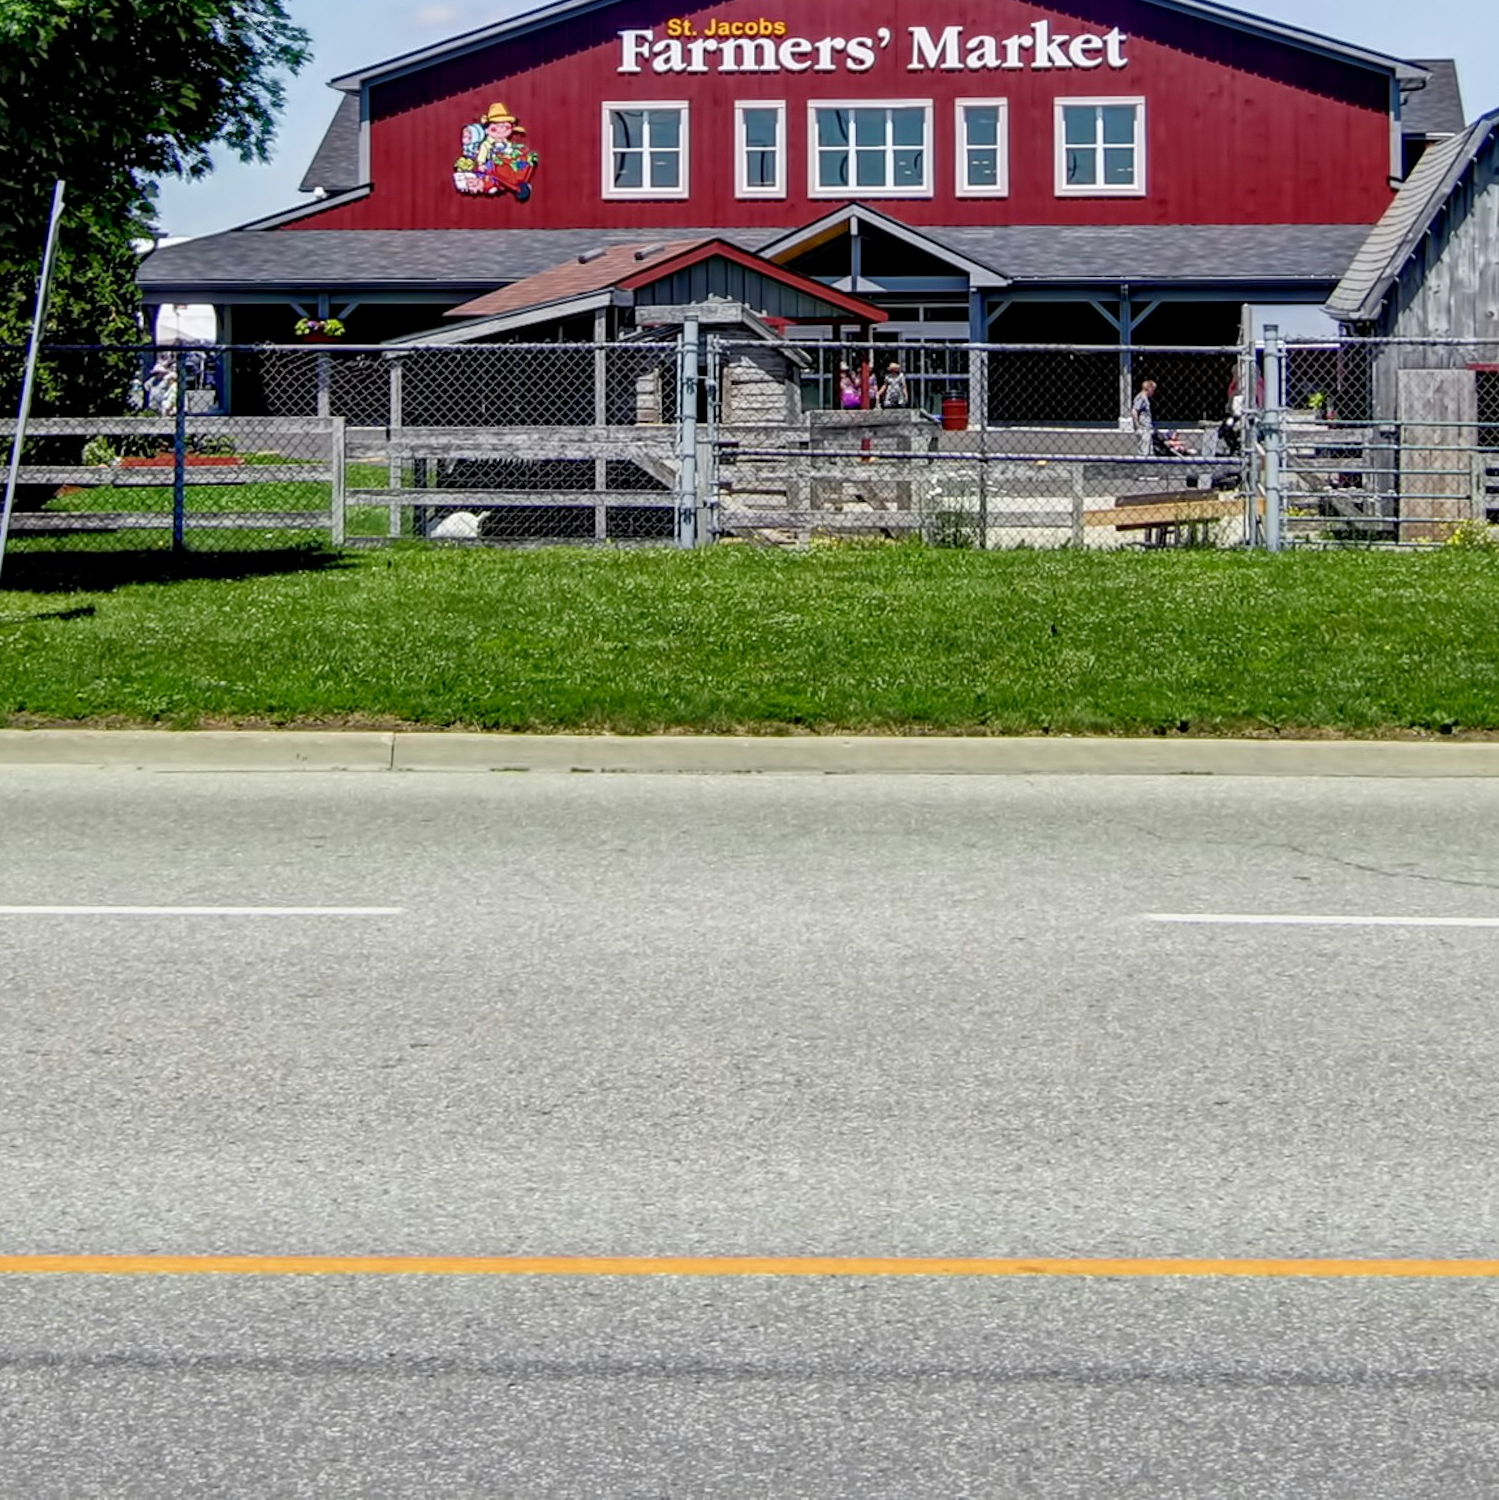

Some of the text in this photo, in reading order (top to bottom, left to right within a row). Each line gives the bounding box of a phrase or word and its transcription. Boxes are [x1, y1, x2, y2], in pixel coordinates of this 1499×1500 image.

[667, 18, 786, 36] St. Jacobs
[907, 19, 1128, 70] Market
